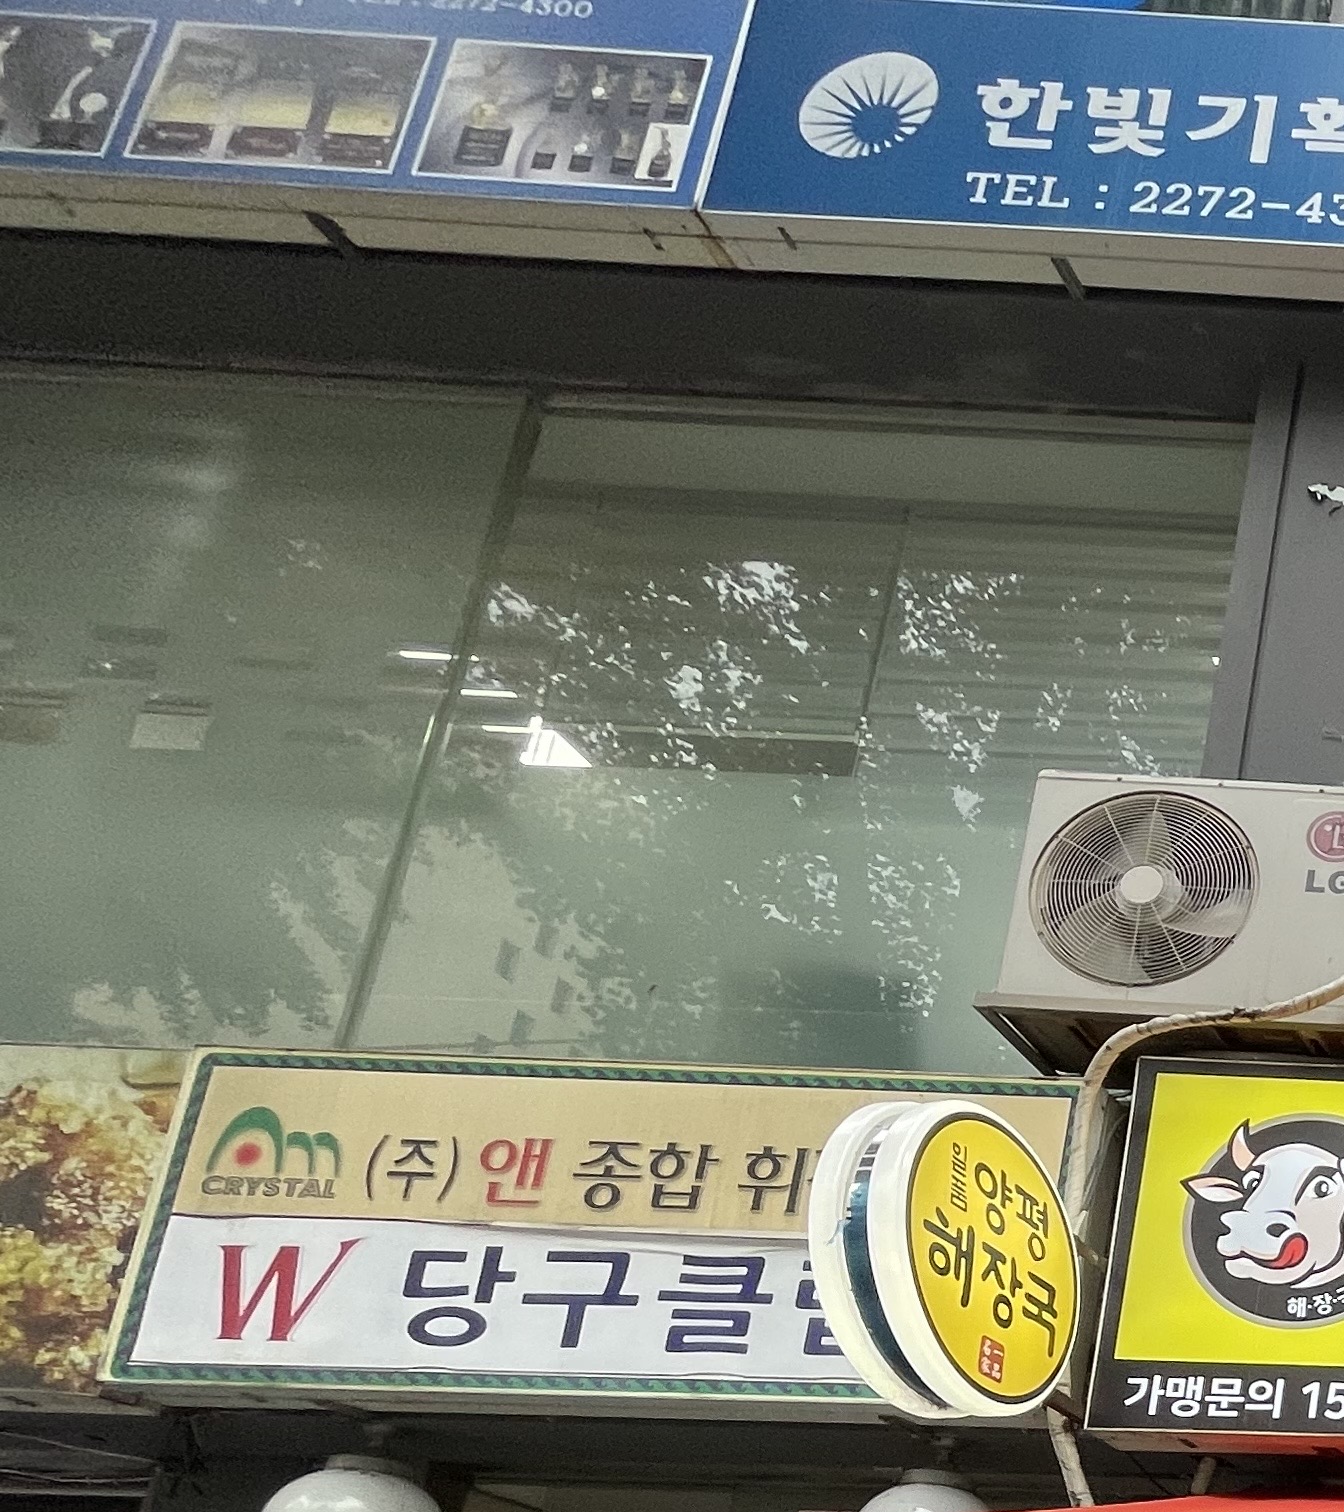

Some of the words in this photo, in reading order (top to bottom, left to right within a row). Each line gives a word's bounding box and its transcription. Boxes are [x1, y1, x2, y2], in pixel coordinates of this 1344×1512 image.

[966, 171, 1070, 209] TEL
[202, 1174, 336, 1200] CRYSTAL
[363, 1133, 460, 1204] (주)
[480, 1137, 553, 1207] 앤
[573, 1139, 720, 1213] 종합
[738, 1145, 814, 1212] 휘
[216, 1236, 365, 1342] W
[1122, 1376, 1282, 1420] 가맹문의
